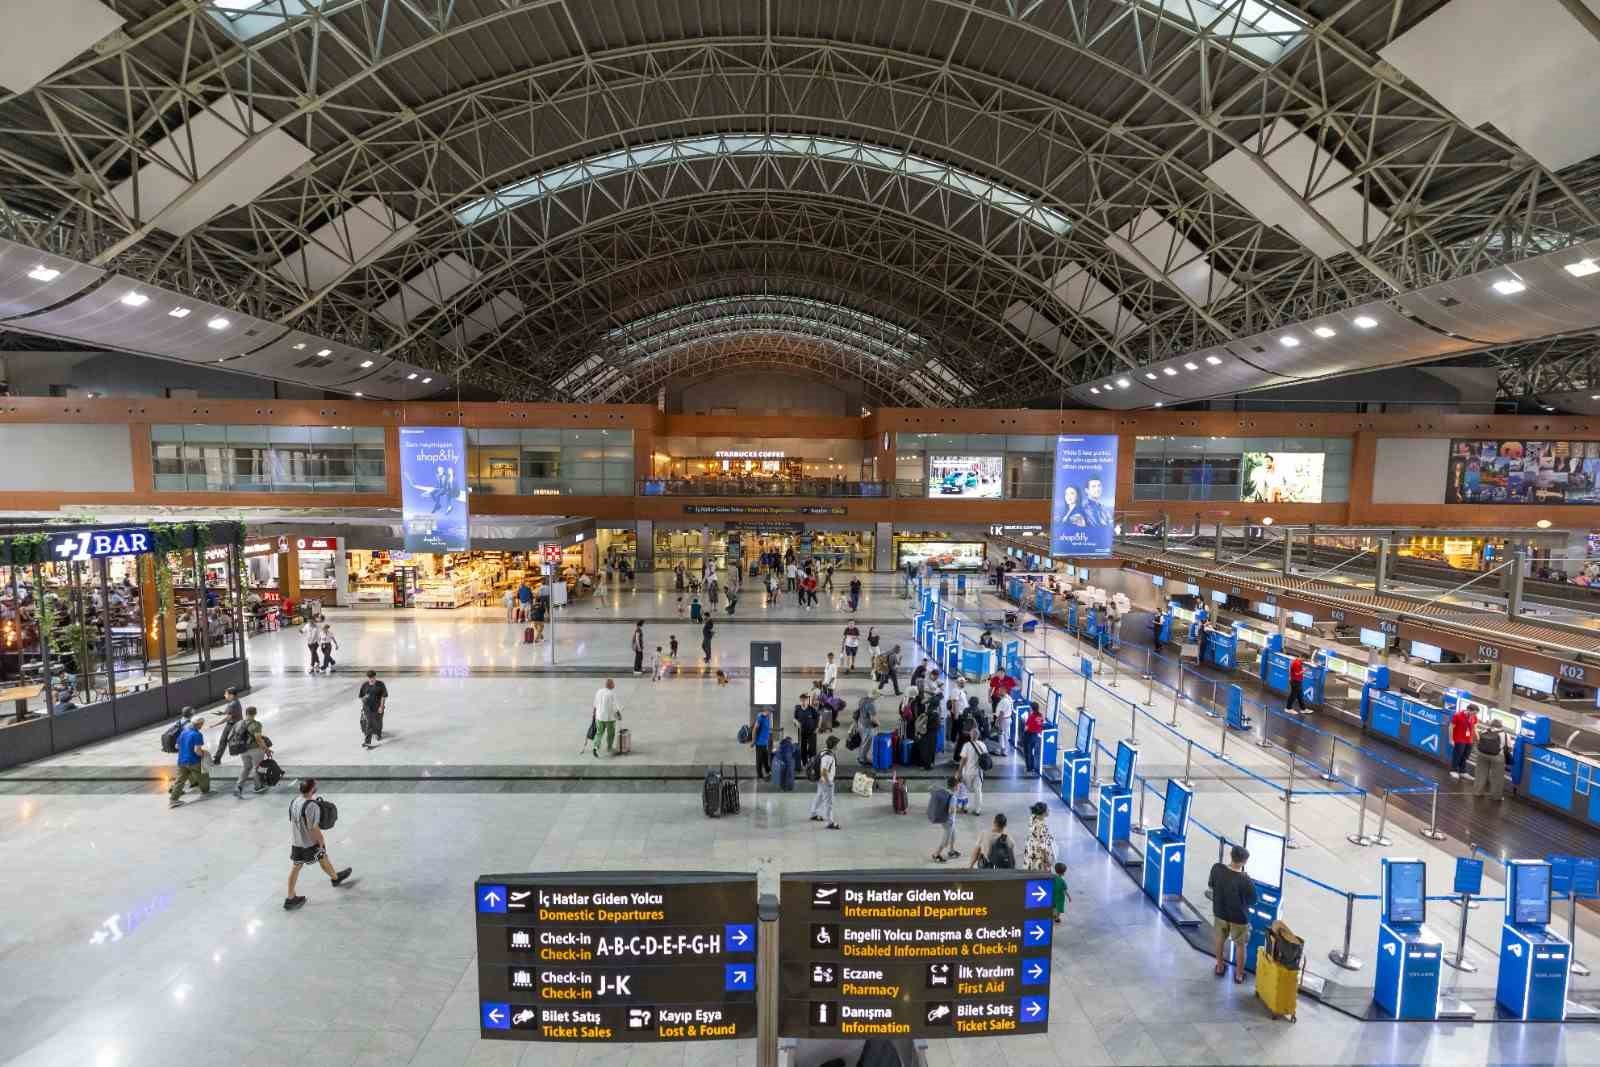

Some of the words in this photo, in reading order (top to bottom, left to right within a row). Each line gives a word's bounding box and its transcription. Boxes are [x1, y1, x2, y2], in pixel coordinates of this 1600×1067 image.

[416, 448, 459, 465] shop&fly
[715, 450, 757, 458] STARBUCKS
[758, 450, 785, 458] COFFEE
[93, 533, 148, 555] BAR
[1478, 644, 1499, 660] K03
[1559, 663, 1585, 681] K02
[1540, 753, 1568, 769] AJet
[539, 890, 550, 907] İç
[553, 893, 589, 905] Hatlar
[592, 893, 628, 905] Giden
[630, 893, 663, 905] Yolcu
[845, 890, 864, 904] Dış
[867, 890, 902, 902] Hatlar
[906, 889, 941, 901] Giden
[943, 889, 974, 901] Yolcu
[539, 908, 595, 921] Domestic
[598, 909, 664, 923] Departures
[844, 905, 920, 918] International
[923, 904, 988, 919] Departures
[540, 931, 592, 945] Check-in
[844, 928, 881, 944] Engelli
[883, 928, 913, 941] Yolcu
[916, 927, 962, 943] Danışma
[965, 928, 974, 940] &
[976, 926, 1022, 939] Check-in
[596, 934, 721, 956] A-B-C-D-E-F-G-H
[843, 944, 891, 957] Disabled
[894, 943, 958, 957] Information
[961, 943, 969, 956] &
[972, 942, 1018, 955] Check-in
[540, 947, 592, 960] Check-in
[541, 971, 592, 984] Check-in
[843, 967, 884, 980] Eczane
[958, 964, 973, 978] İlk
[975, 964, 1014, 978] Yardım
[541, 986, 592, 1000] Check-in
[596, 975, 631, 996] J-K
[842, 984, 899, 998] Pharmacy
[958, 982, 982, 994] First
[986, 981, 1005, 993] Aid
[542, 1009, 570, 1022] Bilet
[572, 1010, 601, 1025] Satış
[659, 1010, 693, 1025] Kayıp
[695, 1010, 722, 1025] Eşya
[842, 1006, 892, 1021] Danışma
[957, 1004, 984, 1017] Bilet
[986, 1004, 1014, 1018] Satış
[543, 1025, 578, 1038] Ticket
[581, 1025, 612, 1038] Sales
[659, 1025, 685, 1038] Lost
[688, 1025, 696, 1037] &
[699, 1023, 736, 1036] Found
[842, 1022, 910, 1034] Information
[957, 1020, 987, 1032] Ticket
[989, 1018, 1016, 1031] Sales
